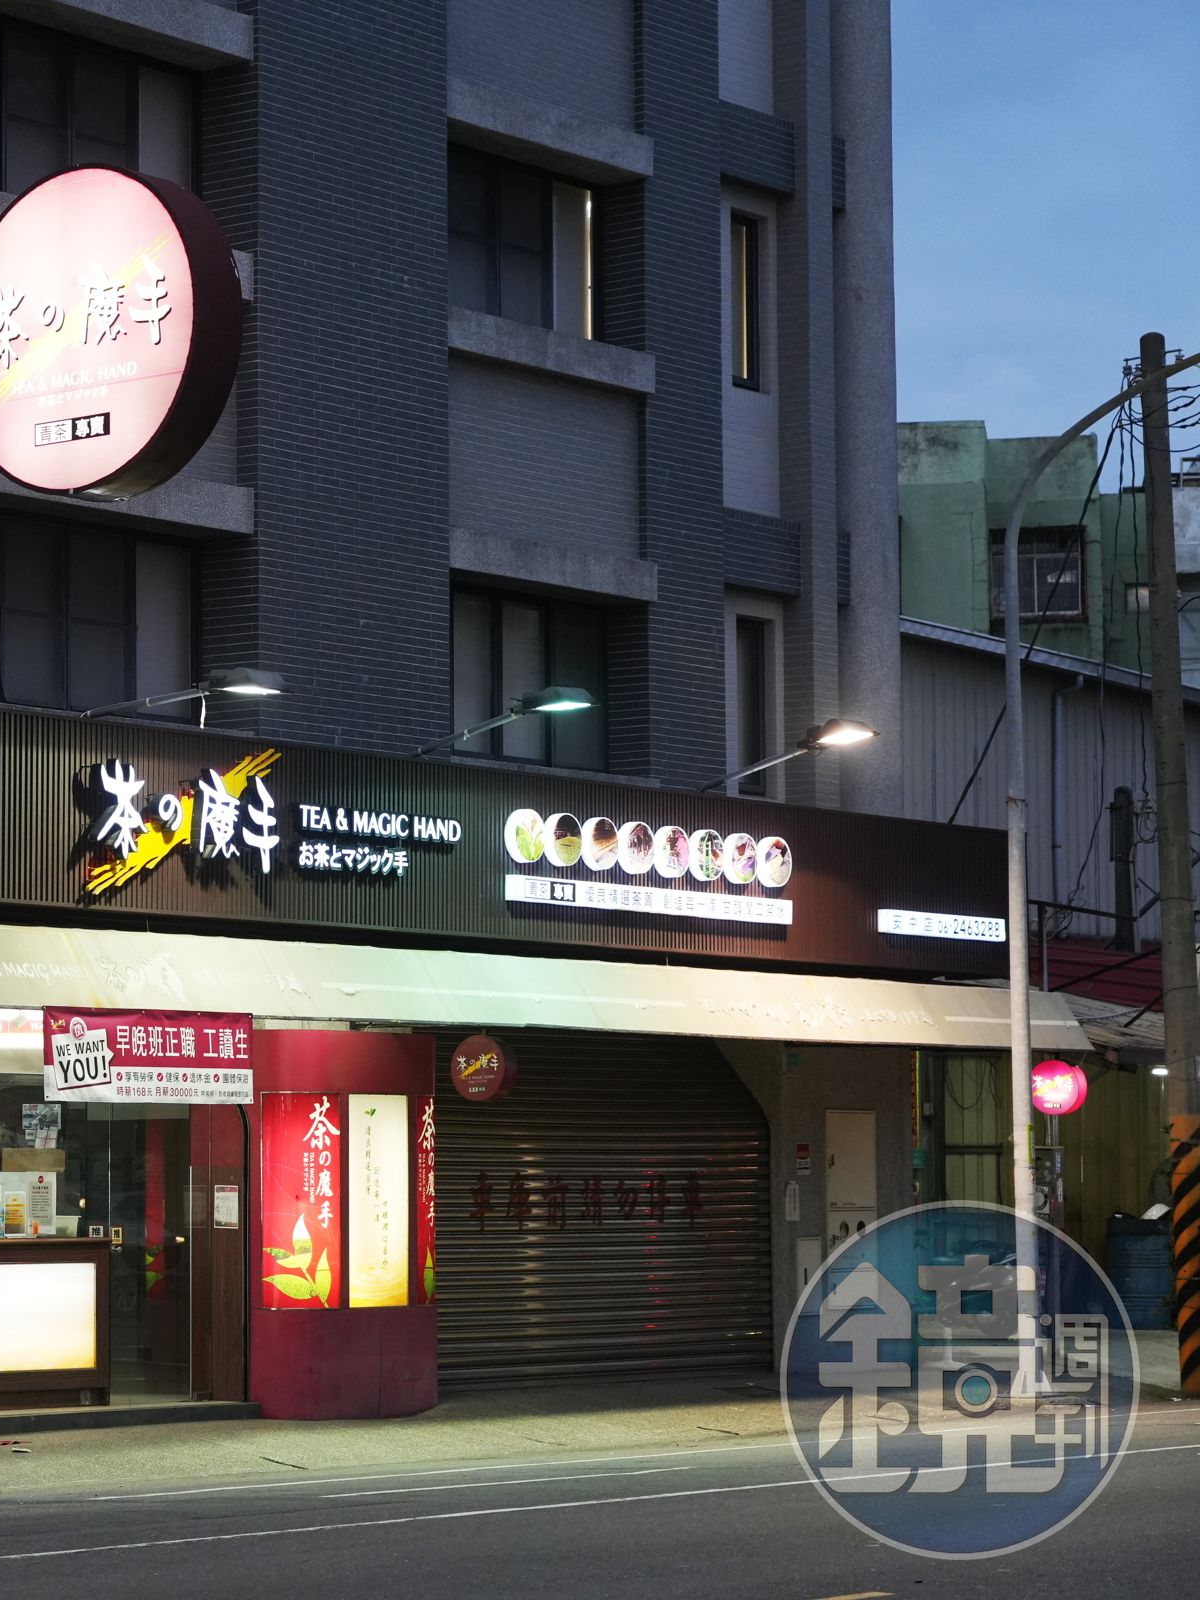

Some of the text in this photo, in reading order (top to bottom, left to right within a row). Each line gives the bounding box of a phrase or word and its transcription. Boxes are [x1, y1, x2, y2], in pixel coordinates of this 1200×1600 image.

[12, 380, 34, 395] TEA
[50, 368, 95, 389] MAGIC
[98, 361, 138, 381] HAND
[97, 758, 280, 875] 茶の魔手
[299, 805, 462, 842] TEA & MAGIC HAND
[298, 841, 409, 876] お茶とマジック手
[56, 1039, 105, 1057] WE WANT
[116, 1025, 249, 1059] 早晚班正職 工讀生
[58, 1055, 108, 1083] YOU!
[302, 1096, 340, 1229] 茶の魔手
